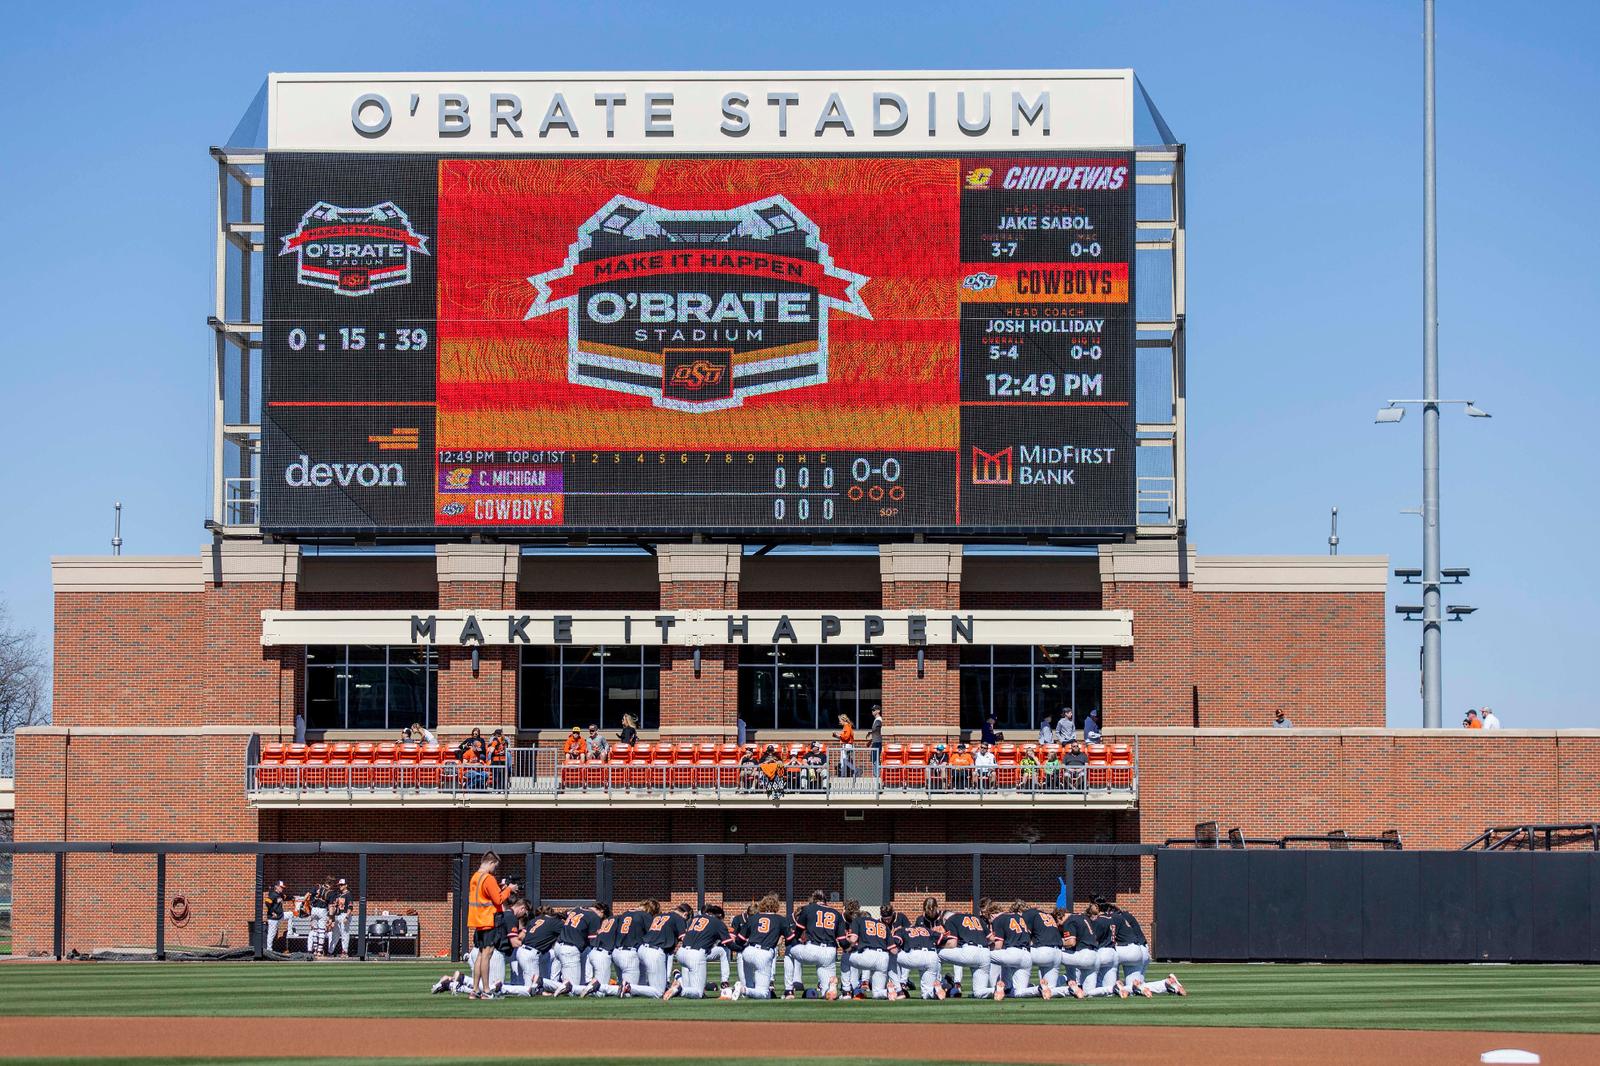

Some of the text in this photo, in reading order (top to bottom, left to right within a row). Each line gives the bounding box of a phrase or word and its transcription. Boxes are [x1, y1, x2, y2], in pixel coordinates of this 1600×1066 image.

[351, 91, 1051, 138] O'BRATE STADIUM
[1003, 166, 1128, 190] CHIPPEWAS
[998, 217, 1093, 230] JAKE SABOL
[305, 243, 404, 257] O'BRATE
[991, 242, 1018, 257] 3-7
[1070, 242, 1101, 257] 0-0
[594, 253, 804, 279] MAKE IT HAPPEN
[1017, 270, 1112, 295] COWBOYS
[586, 292, 811, 324] O'BRATE
[1006, 307, 1085, 317] HEAD COACH
[985, 319, 1105, 333] JOSH HOLLIDAY
[634, 329, 763, 342] STADIUM
[989, 345, 1019, 360] 5-4
[1070, 345, 1102, 360] 0-0
[985, 373, 1103, 396] 12:49 PM
[439, 450, 566, 463] 12:49 PM TOP of 1ST
[570, 453, 828, 464] 1 2 3 4 5 6 7 8 9 R H E
[285, 455, 406, 487] devon
[493, 470, 546, 486] MICHIGAN
[775, 467, 834, 489] 0 0 0
[852, 457, 900, 482] 0-0
[475, 498, 553, 519] COWBOYS
[774, 498, 834, 520] 0 0 0
[411, 615, 974, 645] MAKE IT HAPPEN
[620, 916, 633, 934] 2
[688, 917, 710, 932] 13
[757, 917, 771, 933] 3
[815, 911, 836, 930] 12
[865, 920, 887, 939] 56
